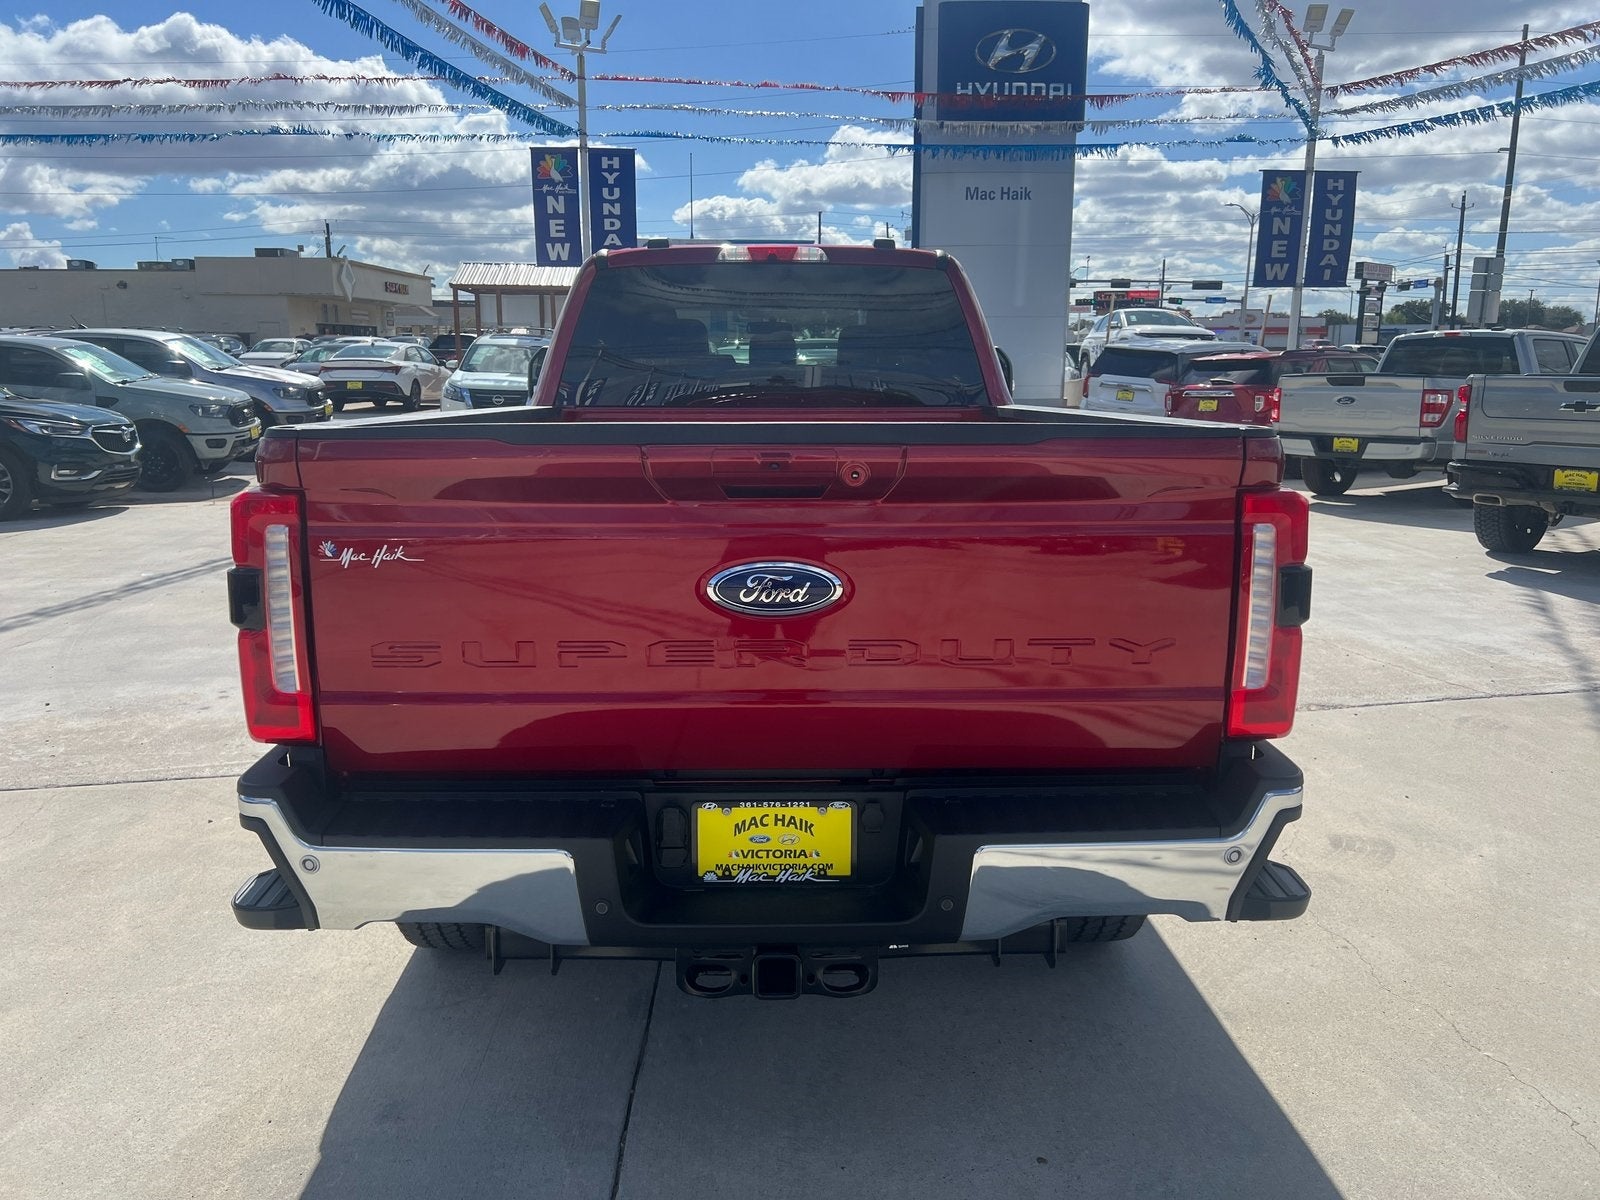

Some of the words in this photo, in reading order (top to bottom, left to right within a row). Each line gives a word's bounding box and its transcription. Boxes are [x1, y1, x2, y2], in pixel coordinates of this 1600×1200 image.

[956, 82, 1072, 99] HYUNDAI
[601, 156, 622, 246] HYUNDA
[965, 187, 996, 201] Mac
[1000, 186, 1032, 201] Haik
[546, 195, 570, 261] NEW
[1319, 178, 1345, 281] HYUNDAI
[1265, 217, 1291, 281] NEW
[339, 547, 371, 569] Mac
[371, 544, 405, 569] Haik
[739, 573, 811, 603] Ford
[370, 639, 808, 669] SUPER
[846, 637, 1176, 668] DUTY
[734, 814, 770, 837] MAC
[774, 814, 815, 837] HAIK
[740, 849, 809, 859] VICTORIA
[715, 863, 834, 871] MACHAIKVICTORIA.COM
[734, 868, 774, 884] Mac
[774, 868, 816, 884] Haik
